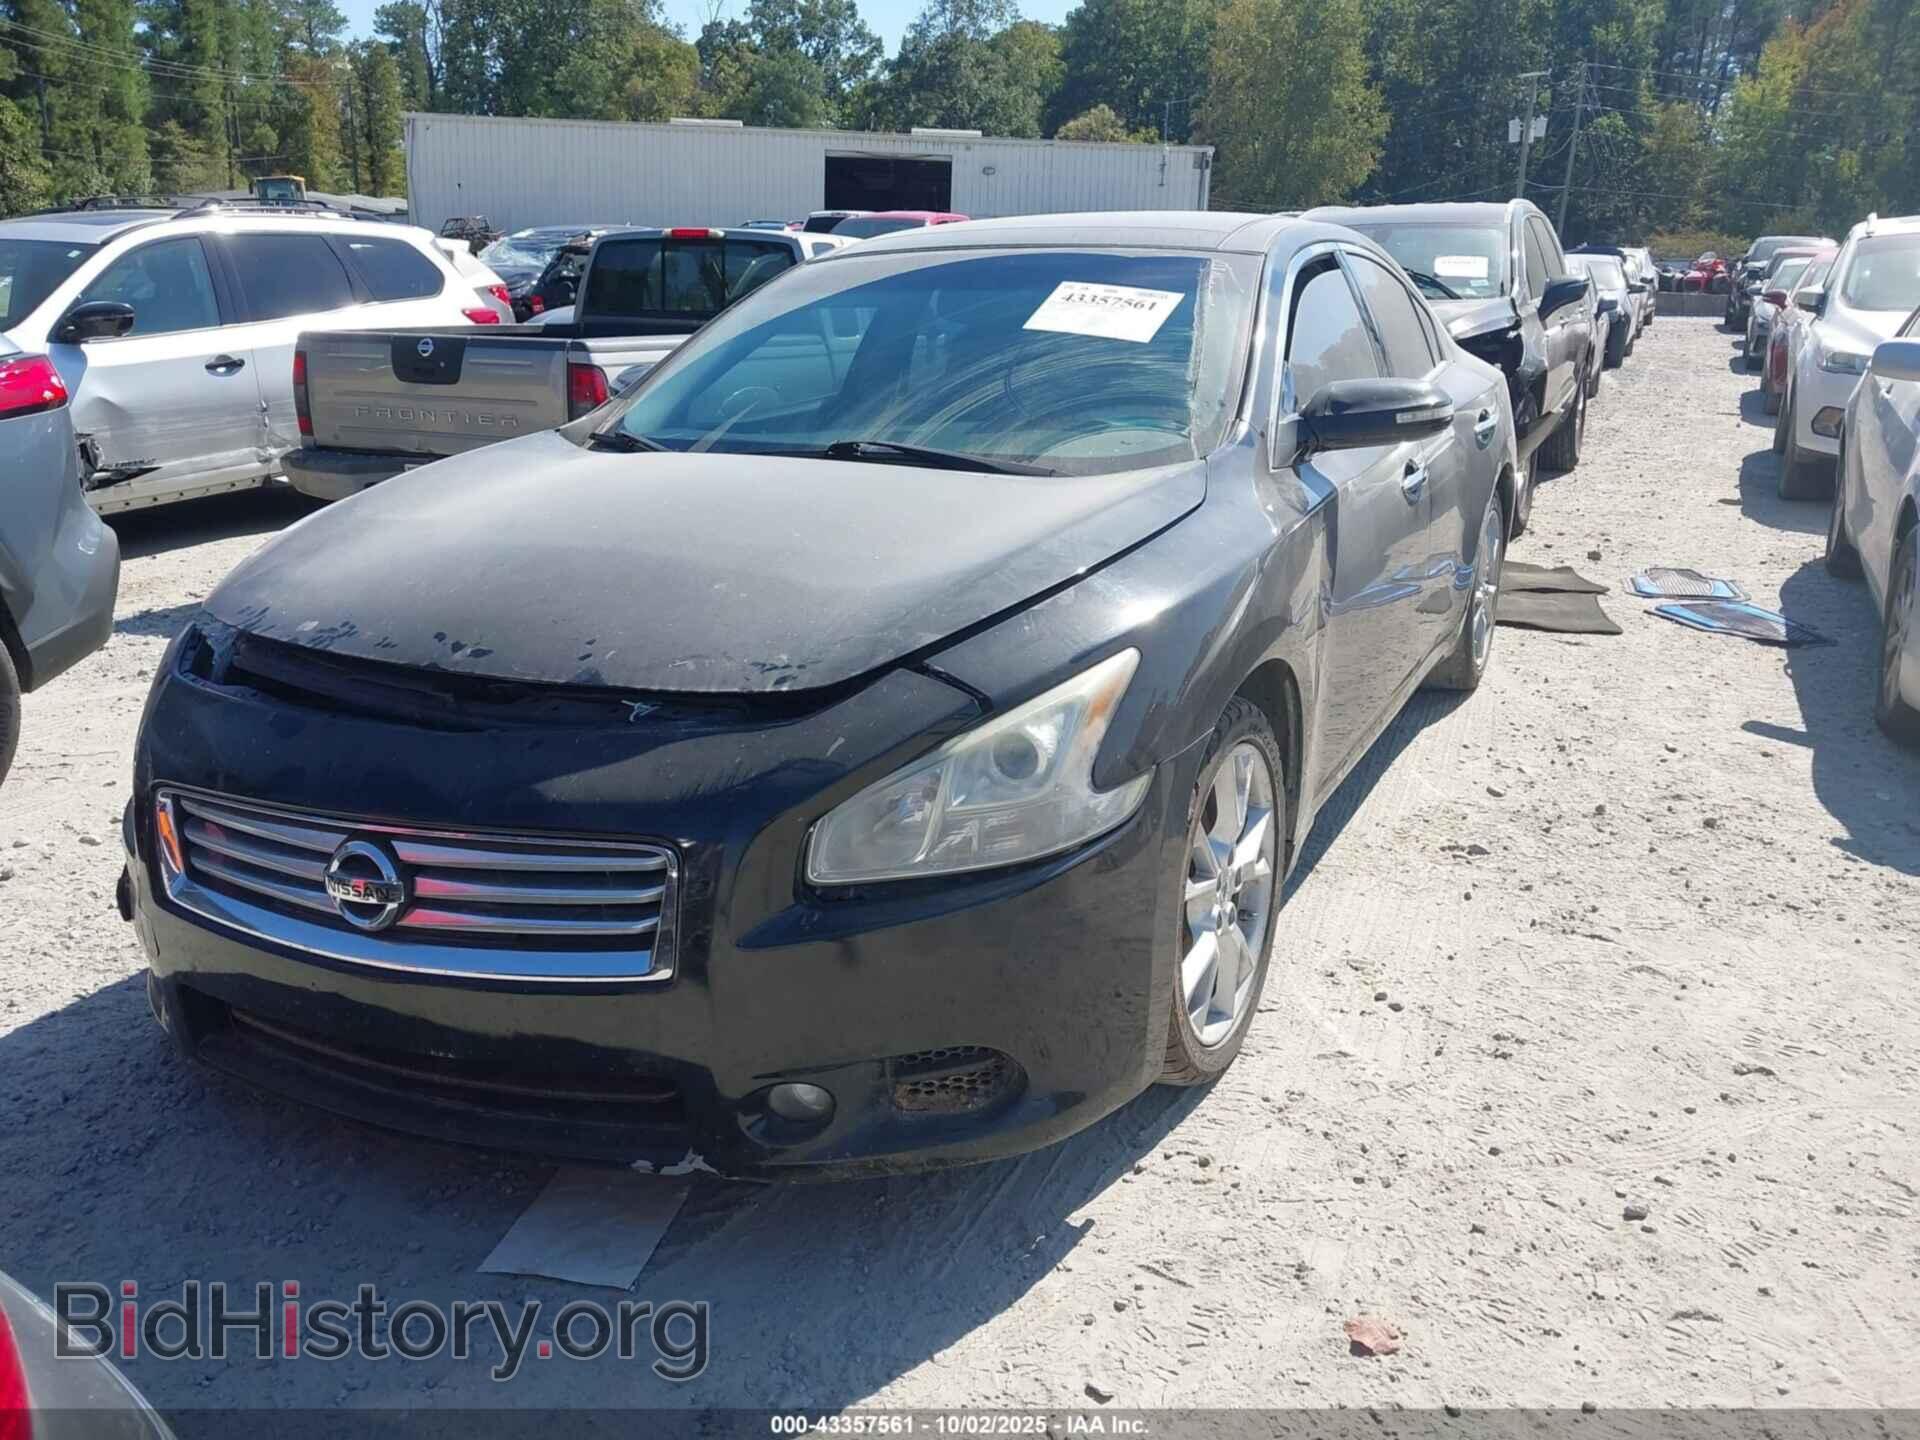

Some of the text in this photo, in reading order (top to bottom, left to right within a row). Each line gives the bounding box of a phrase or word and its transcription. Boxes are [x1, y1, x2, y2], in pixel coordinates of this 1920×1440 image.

[1061, 292, 1157, 310] 43357561
[354, 405, 520, 427] FRONTIER
[328, 879, 389, 902] NISSAN
